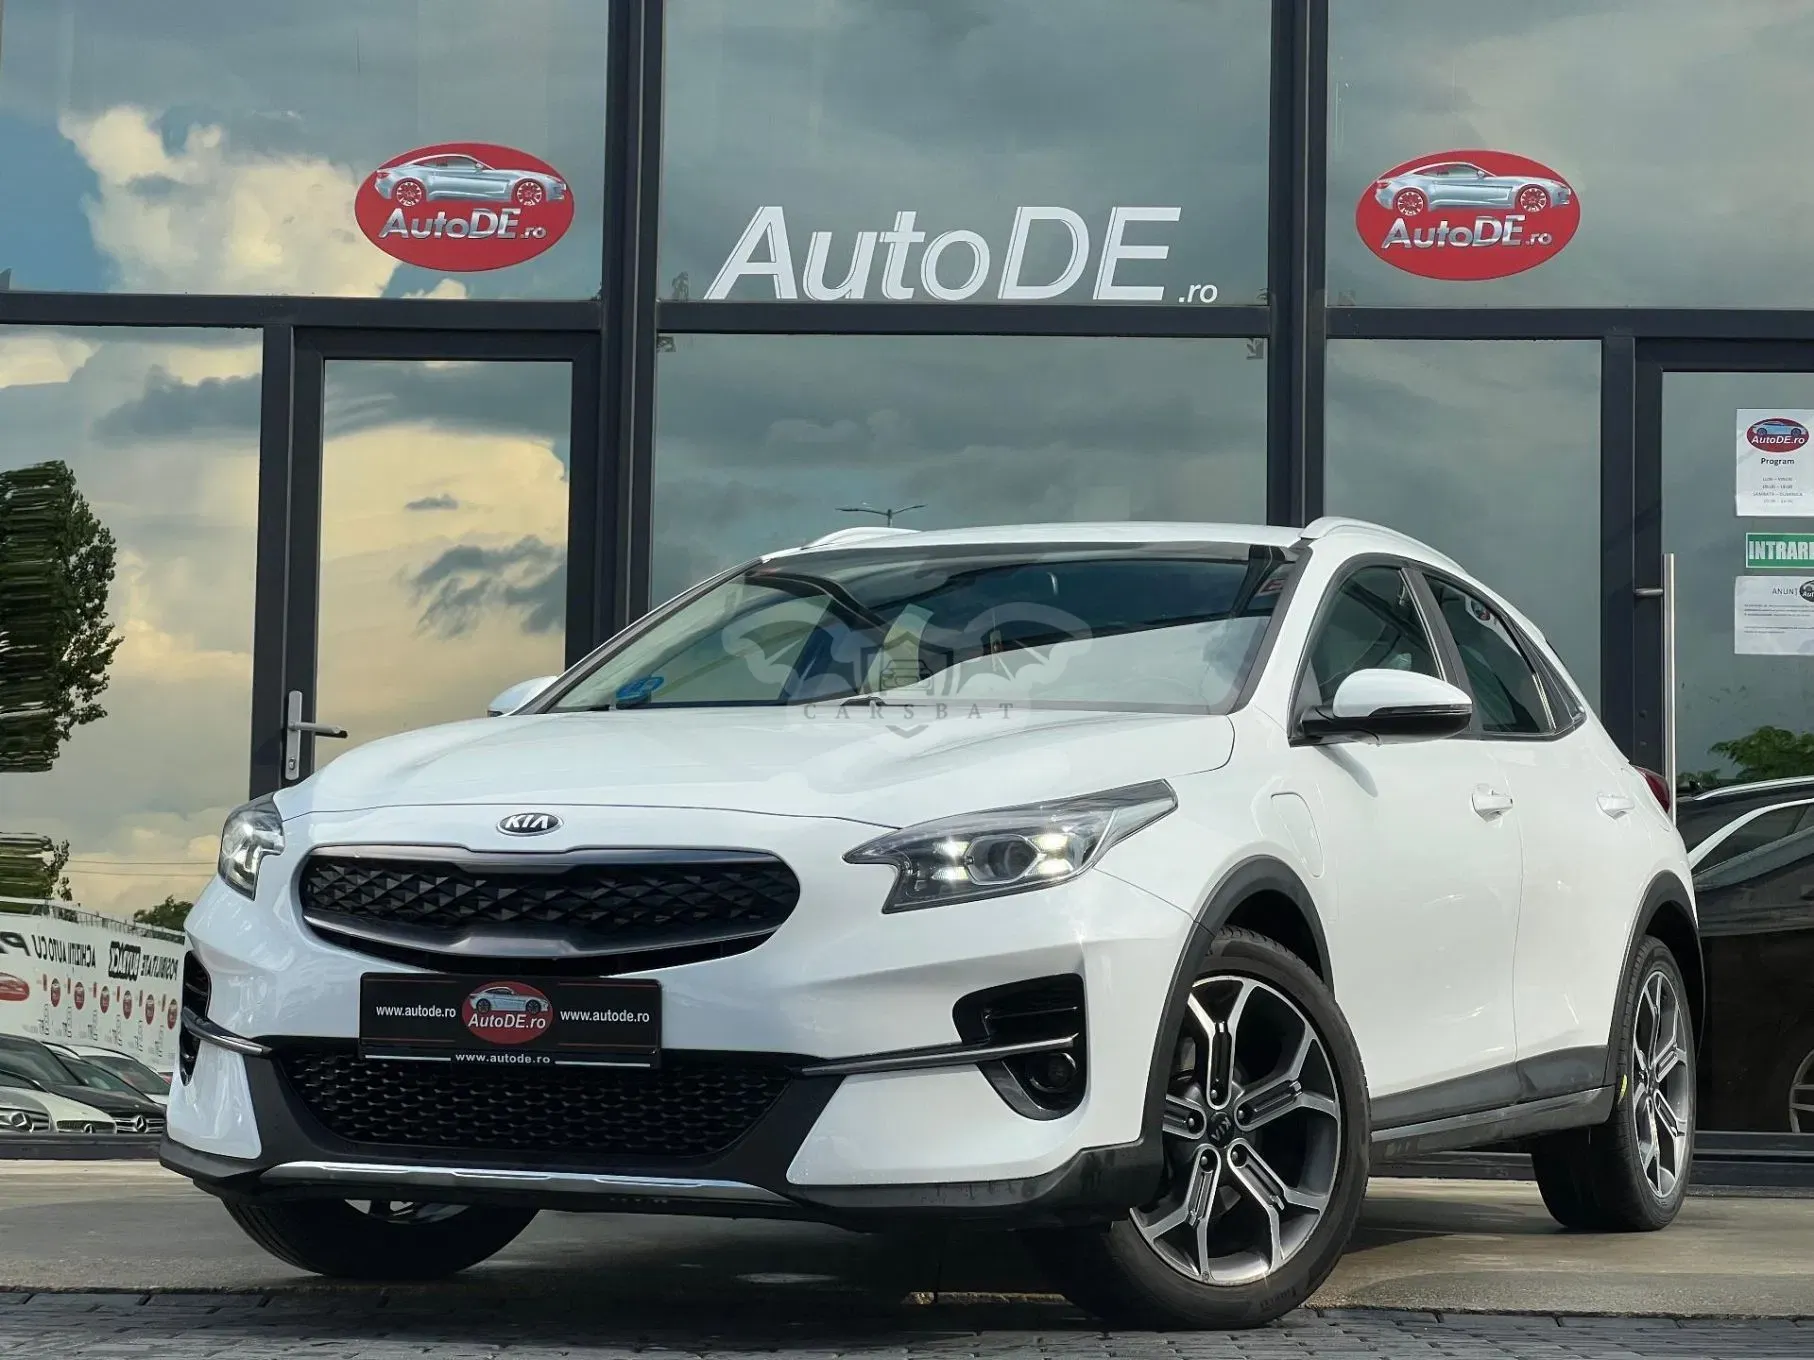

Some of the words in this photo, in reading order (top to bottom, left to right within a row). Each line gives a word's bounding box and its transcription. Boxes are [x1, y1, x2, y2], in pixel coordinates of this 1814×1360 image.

[1751, 435, 1805, 444] AutoDE.ro
[1760, 457, 1795, 466] Program
[505, 814, 549, 829] KIA
[376, 1005, 456, 1018] www.autode.ro
[560, 1010, 650, 1023] www.autode.ro
[468, 1013, 546, 1029] AutoDE.ro
[455, 1053, 551, 1064] www.autode.ro
[1211, 1117, 1231, 1140] KIA
